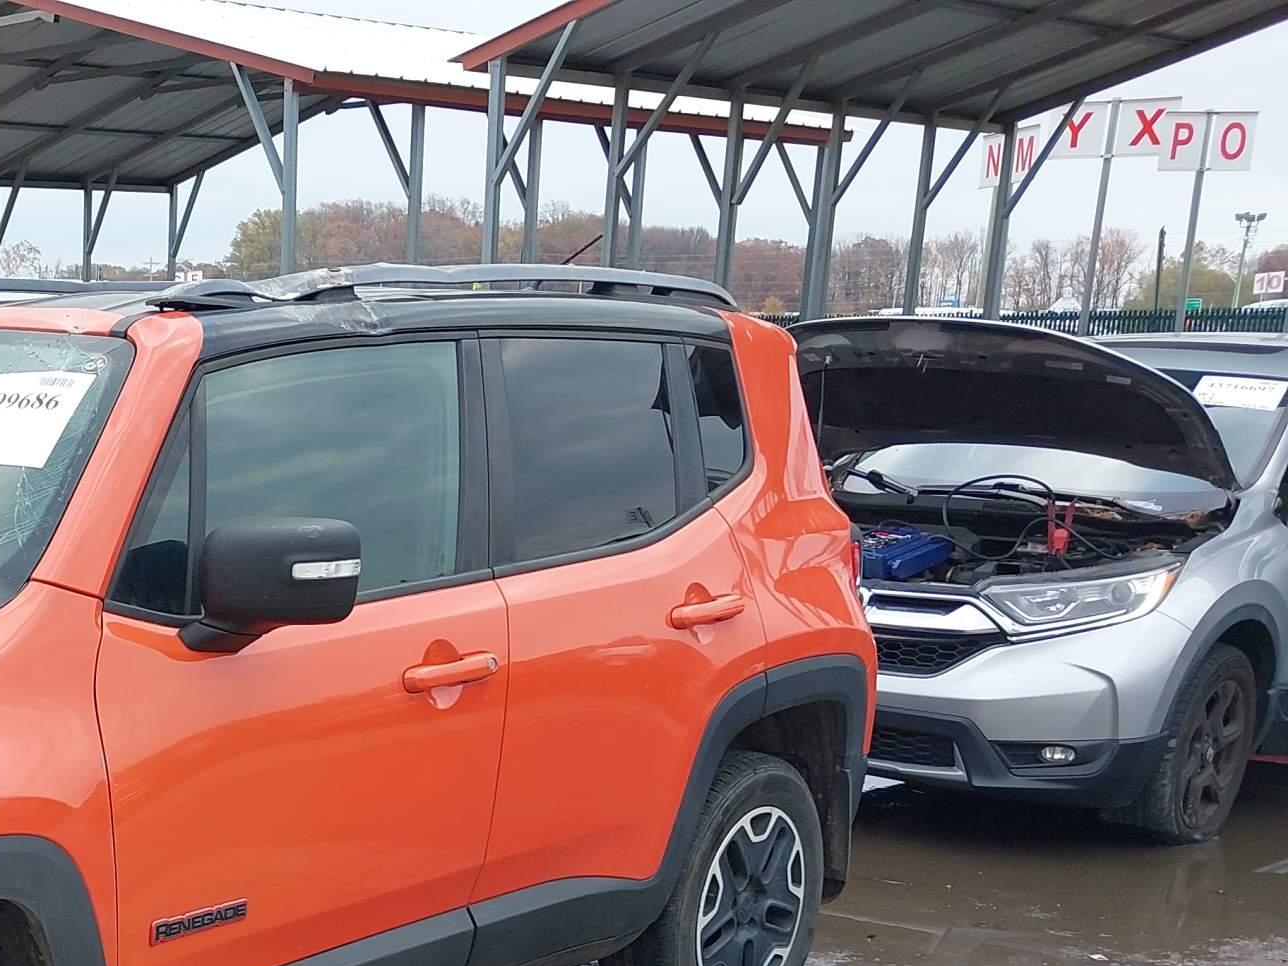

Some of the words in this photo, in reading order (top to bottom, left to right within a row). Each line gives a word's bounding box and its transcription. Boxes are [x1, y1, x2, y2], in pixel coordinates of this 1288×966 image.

[1065, 111, 1094, 149] Y
[1128, 108, 1167, 147] X
[1169, 122, 1195, 160] P
[1220, 122, 1247, 160] O
[986, 143, 1001, 178] N
[1015, 136, 1035, 172] M
[155, 903, 247, 941] RENEGADE
